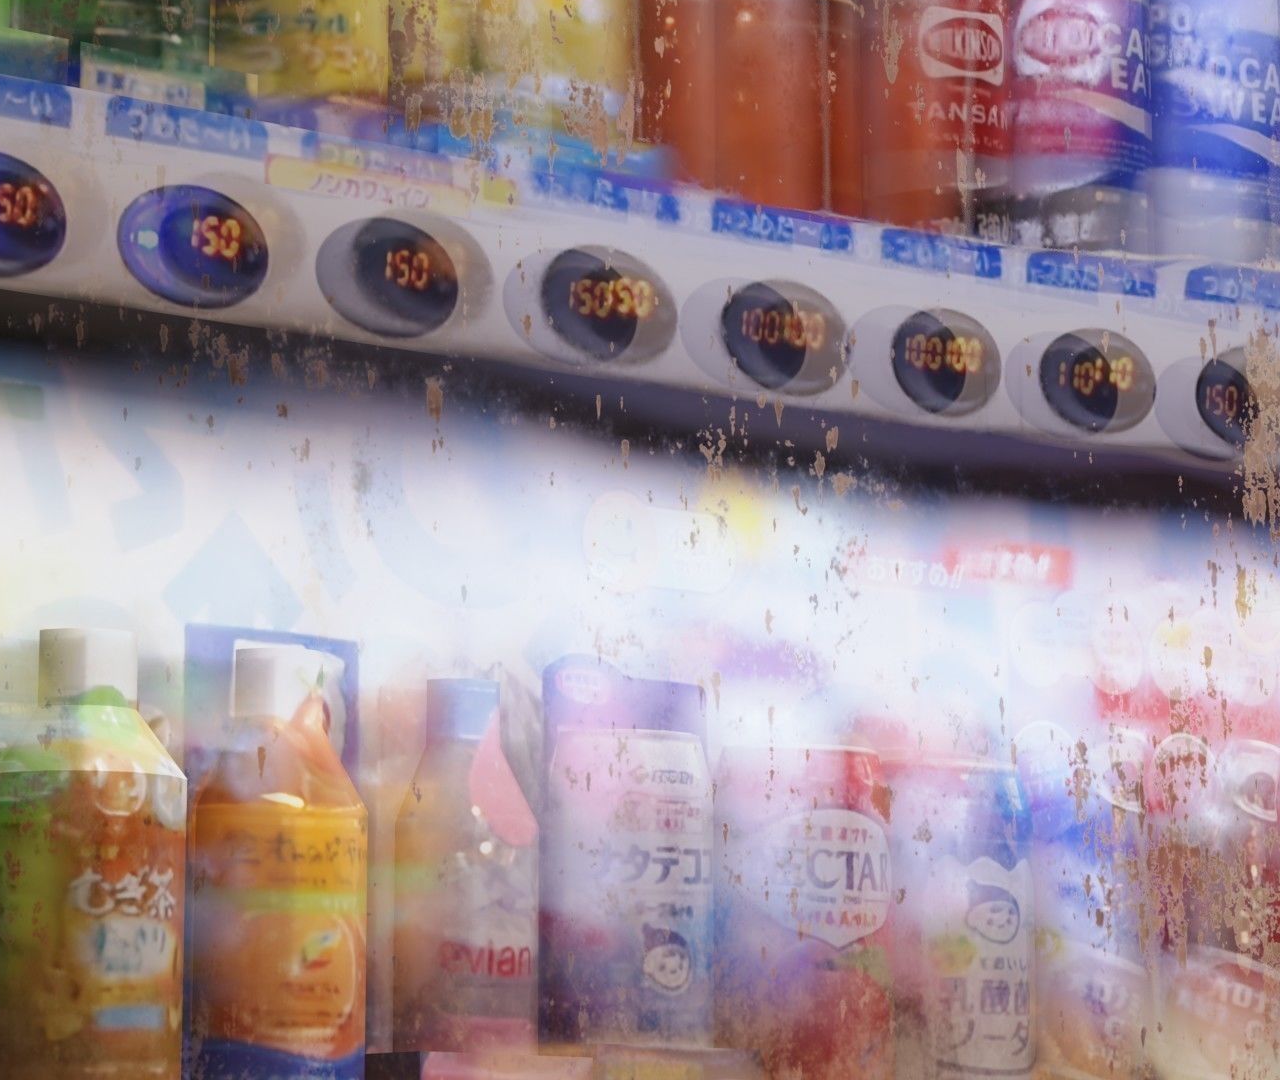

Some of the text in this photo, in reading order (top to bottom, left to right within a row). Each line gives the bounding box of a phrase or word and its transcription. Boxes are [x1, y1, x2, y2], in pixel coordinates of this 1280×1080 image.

[191, 215, 241, 259] 150
[385, 250, 429, 291] 150
[782, 847, 889, 894] ECTAR
[70, 867, 177, 920] むぎ茶
[439, 942, 533, 981] evian
